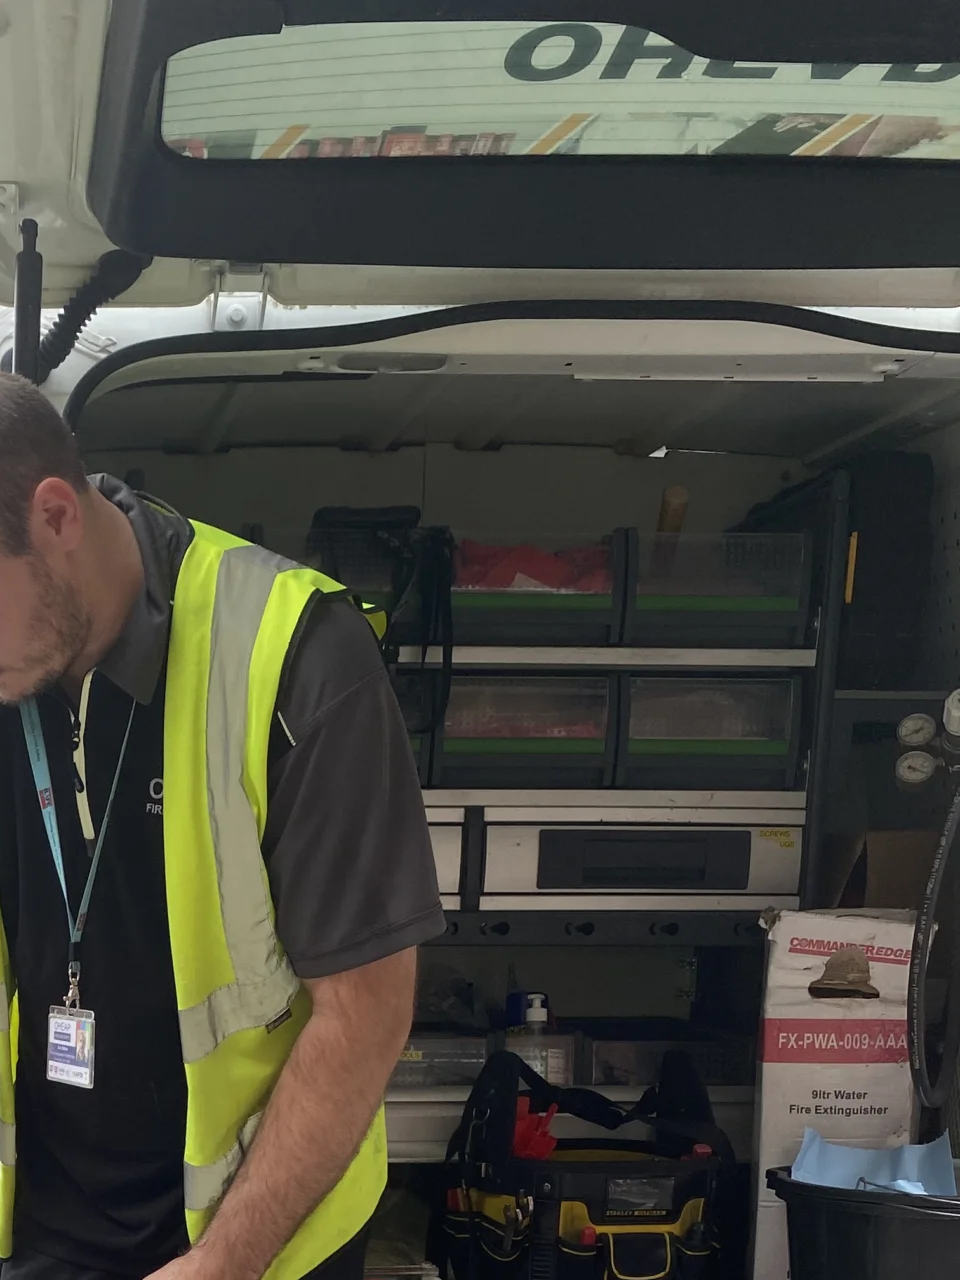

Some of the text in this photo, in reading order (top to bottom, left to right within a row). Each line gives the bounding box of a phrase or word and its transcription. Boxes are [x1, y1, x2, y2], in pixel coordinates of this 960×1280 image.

[778, 1033, 908, 1050] FX-PWA-009-AAA
[834, 1090, 868, 1100] Water
[789, 1105, 888, 1117] Fire Extinguisher
